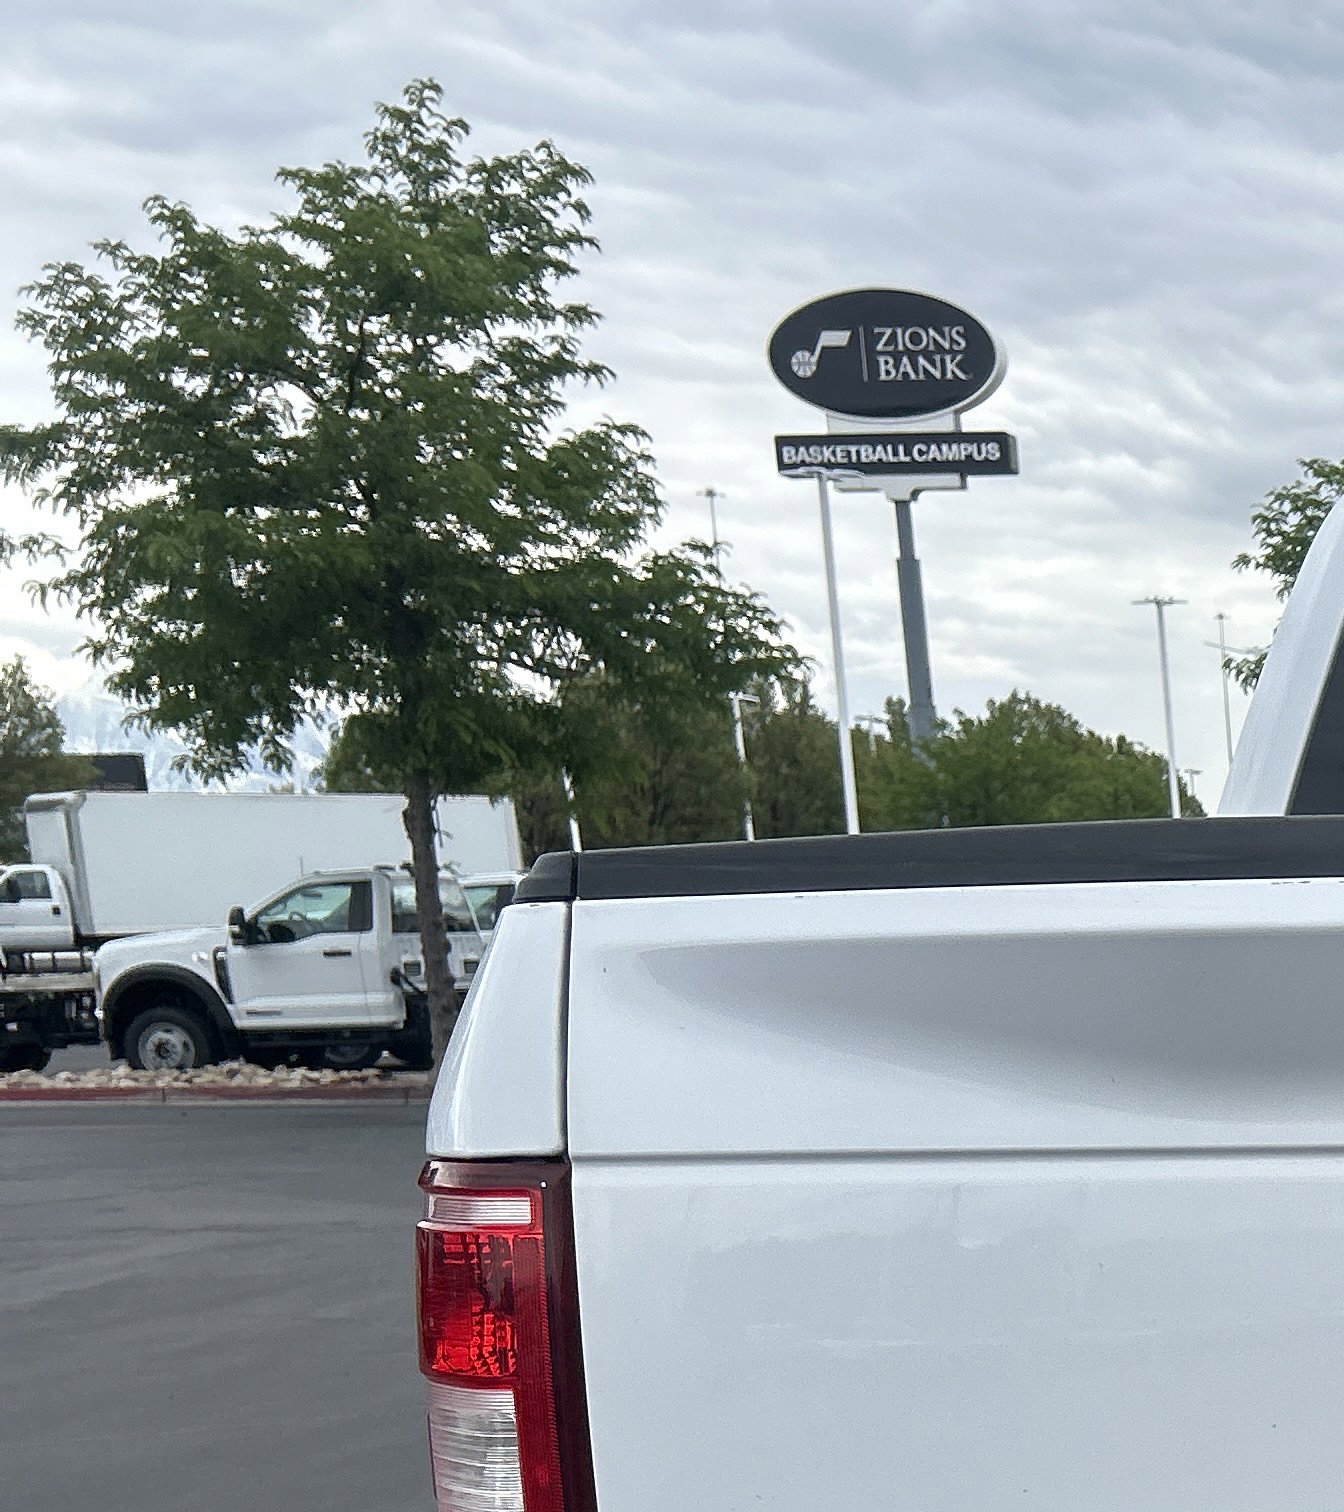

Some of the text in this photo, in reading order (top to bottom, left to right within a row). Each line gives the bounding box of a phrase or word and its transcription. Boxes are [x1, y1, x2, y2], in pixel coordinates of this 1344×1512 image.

[873, 325, 967, 352] ZIONS
[876, 353, 968, 381] BANK
[782, 442, 1001, 464] BASKETBALL CAMPUS
